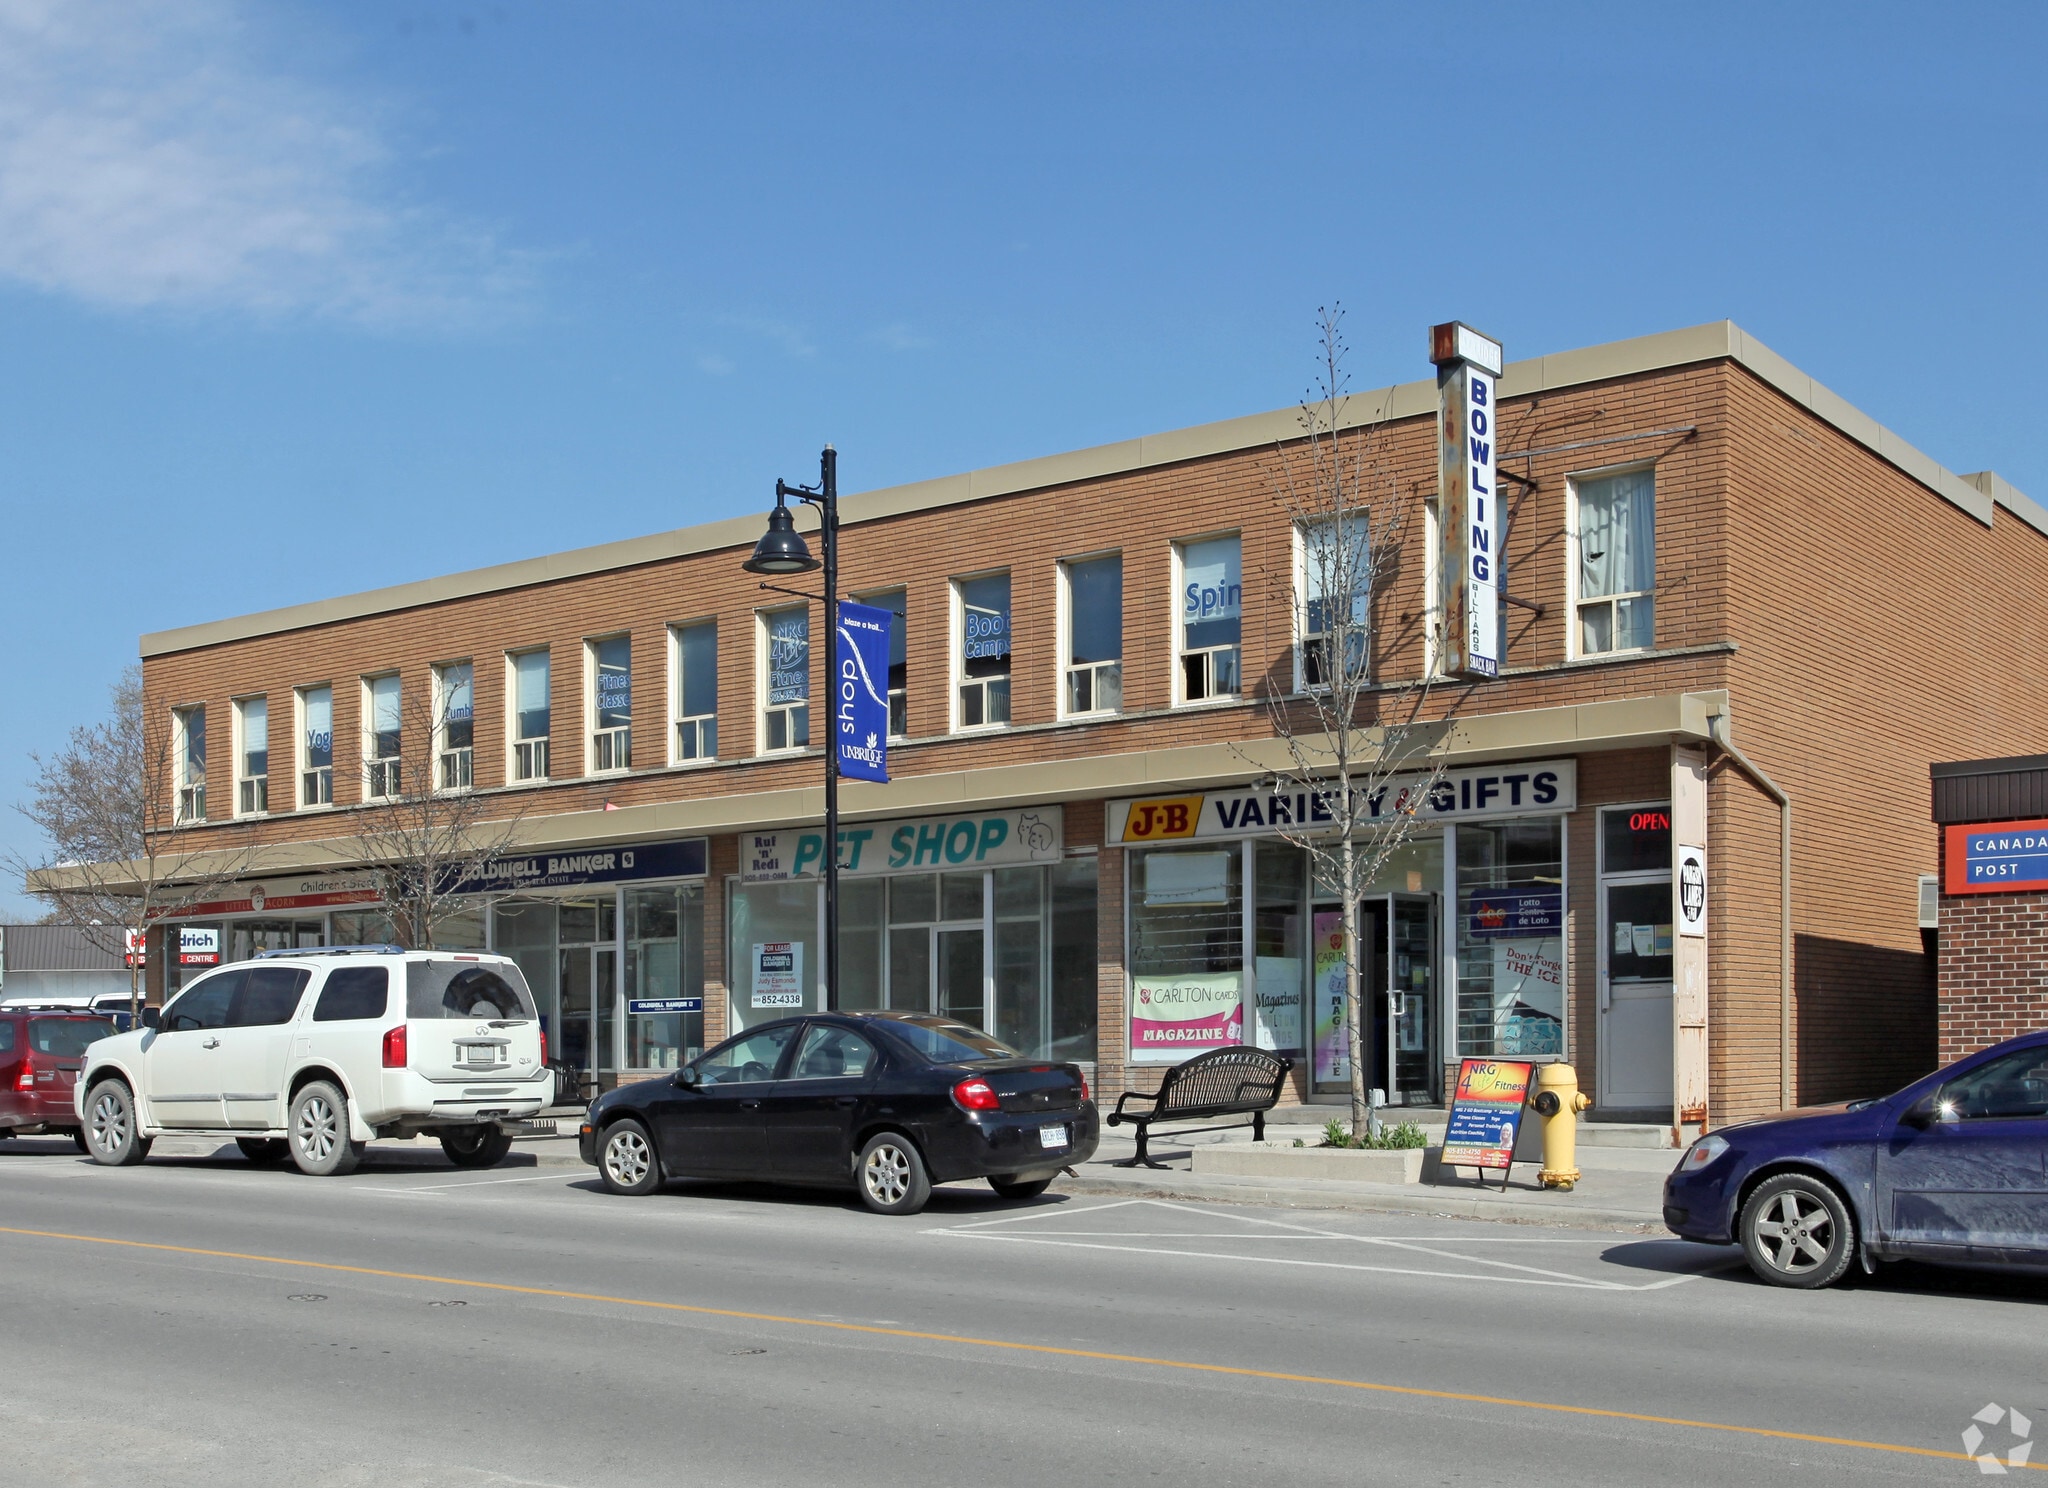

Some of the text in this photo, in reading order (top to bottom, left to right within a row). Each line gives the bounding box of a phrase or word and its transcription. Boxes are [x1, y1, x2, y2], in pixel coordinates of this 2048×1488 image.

[1470, 376, 1489, 582] BOWLING
[1186, 579, 1241, 617] Spin
[775, 620, 808, 638] NRG
[844, 617, 861, 627] blaze
[966, 610, 1011, 639] Boot
[1469, 655, 1496, 674] SNACK BAR
[838, 659, 859, 734] shop
[446, 703, 473, 719] Zumb
[841, 744, 883, 764] UXBRIDGE
[1215, 786, 1389, 829] VARIETY
[1396, 787, 1414, 815] &
[1431, 772, 1558, 812] GIFTS
[1629, 813, 1670, 831] OPEN
[754, 835, 776, 848] Ruf
[792, 818, 1008, 875] PET SHOP
[1975, 837, 2048, 851] CANADA
[548, 854, 616, 874] BANKER
[752, 859, 779, 870] Redi
[1975, 863, 2018, 877] POST
[225, 897, 295, 911] LITTLE ACORN
[1519, 899, 1540, 907] Lotto
[1519, 908, 1545, 916] Centre
[1518, 917, 1550, 925] de Loto
[186, 955, 214, 963] CENTRE
[1506, 947, 1534, 962] Don't
[1506, 960, 1562, 985] THE ICE
[761, 994, 800, 1004] 852-4338
[1154, 987, 1239, 1004] CARLTON CARDS
[1256, 991, 1300, 1014] Magazines
[1257, 1014, 1295, 1028] CARLTON
[1142, 1027, 1223, 1042] MAGAZINE
[1264, 1031, 1293, 1044] CARDS
[1331, 996, 1342, 1077] MAGAZINE
[1469, 1063, 1496, 1075] NRG
[1461, 1073, 1472, 1094] 4
[1494, 1081, 1527, 1091] Fitness
